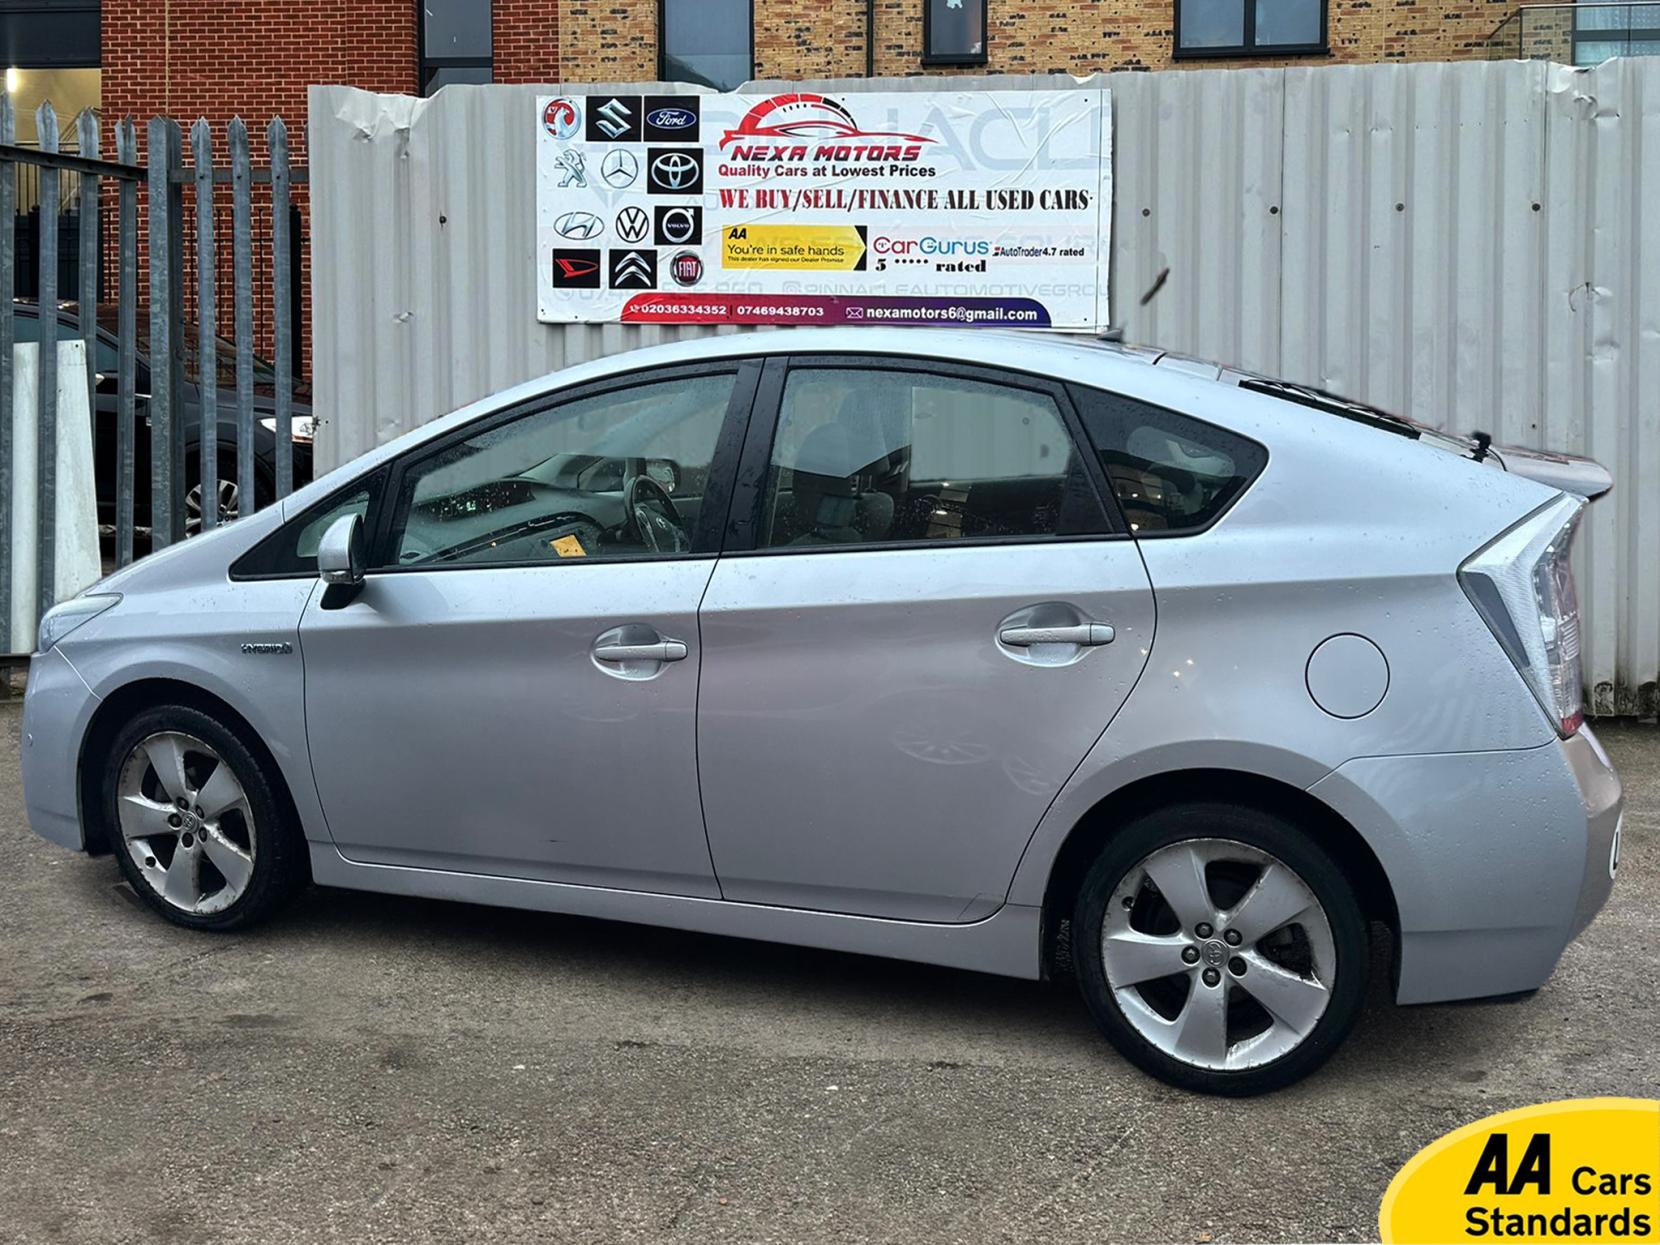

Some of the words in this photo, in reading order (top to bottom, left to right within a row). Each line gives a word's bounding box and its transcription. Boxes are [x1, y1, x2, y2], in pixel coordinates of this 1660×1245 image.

[656, 111, 687, 126] Ford
[731, 146, 808, 161] NEXA
[813, 146, 922, 161] MOTORS
[718, 164, 770, 179] Quality
[775, 164, 808, 177] Cars
[812, 166, 827, 177] at
[832, 164, 885, 177] Lowest
[890, 164, 936, 177] Prices
[719, 189, 748, 208] WE
[755, 189, 938, 212] BUY/SELL/FINANCE
[944, 190, 980, 209] ALL
[986, 190, 1034, 210] USED
[1040, 189, 1089, 210] CARS
[728, 227, 747, 240] AA
[727, 244, 764, 255] You're
[767, 244, 777, 255] in
[780, 245, 805, 256] safe
[808, 245, 844, 256] hands
[873, 236, 989, 255] CarGurus
[1059, 247, 1085, 257] rated
[678, 261, 697, 277] FIAT
[875, 258, 887, 272] 5
[936, 259, 987, 273] rated
[641, 305, 727, 315] 02036334352
[737, 306, 824, 317] 07469438703
[866, 307, 1038, 322] nexamotors6@gmail.com
